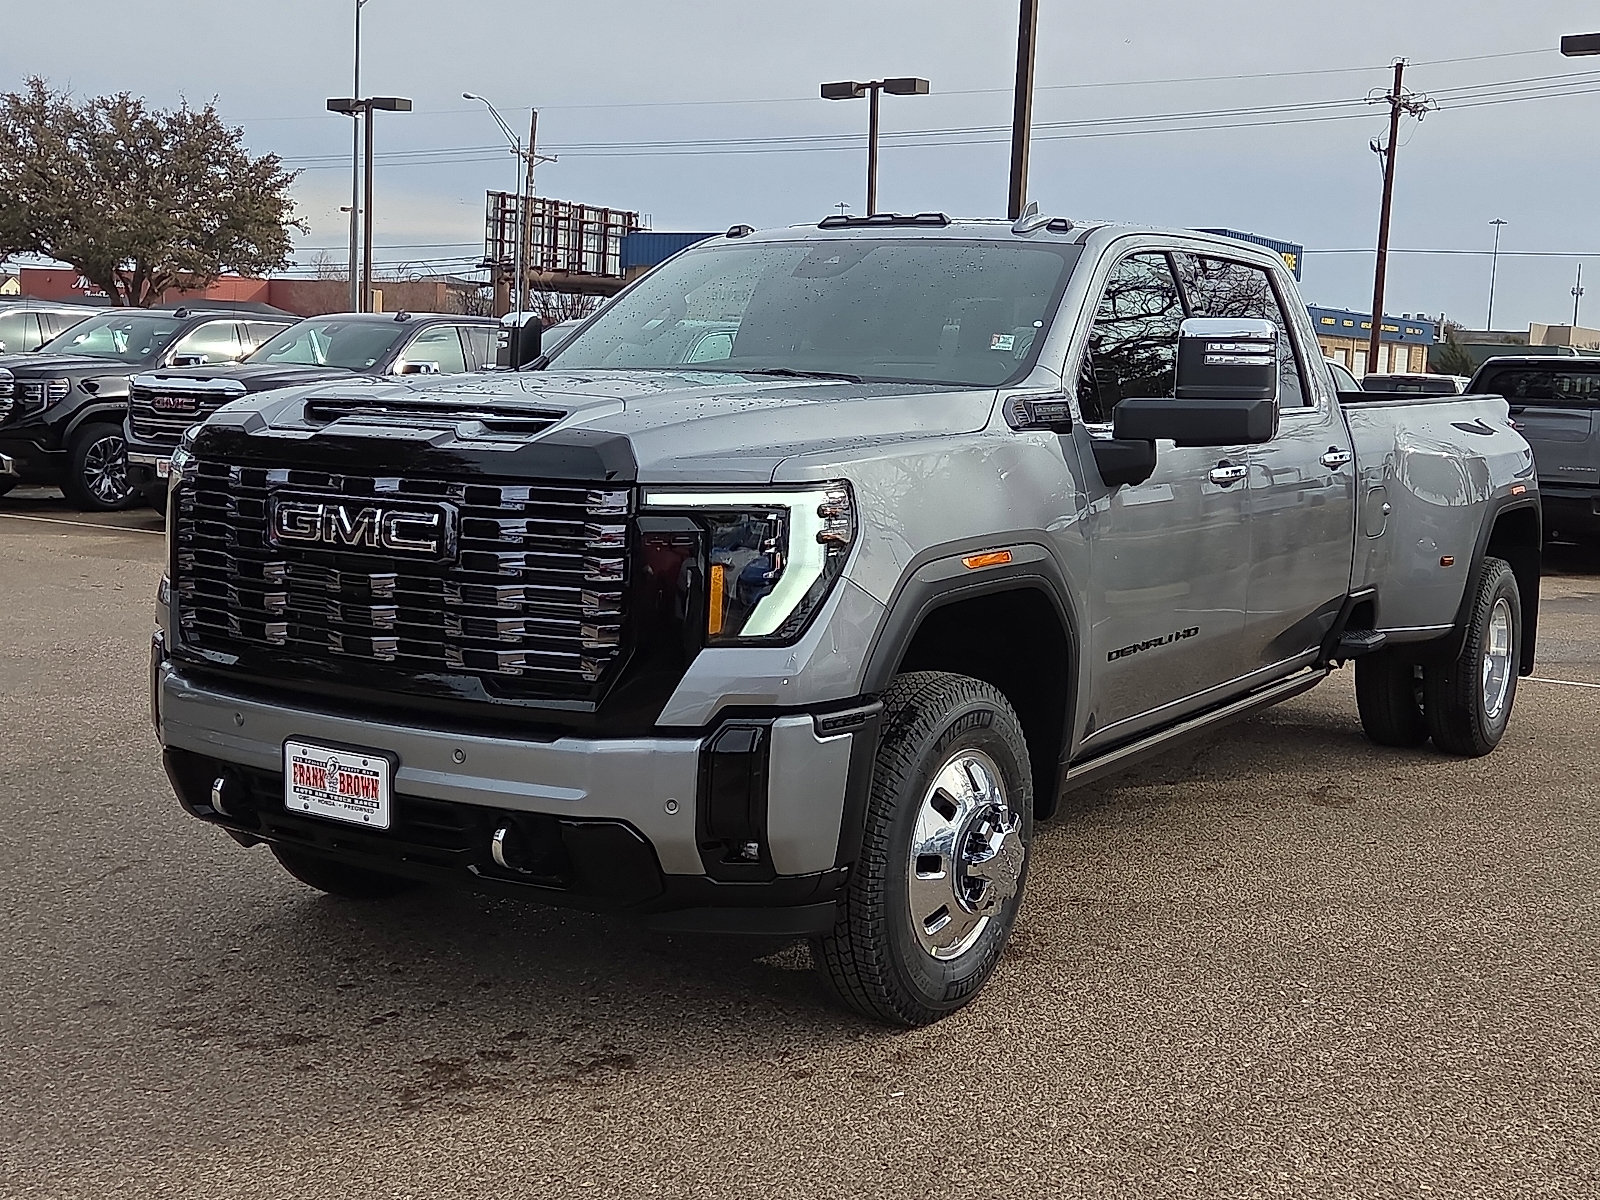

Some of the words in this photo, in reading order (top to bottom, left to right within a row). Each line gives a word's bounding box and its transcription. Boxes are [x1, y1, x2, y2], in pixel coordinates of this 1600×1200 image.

[152, 397, 195, 410] GMC
[274, 501, 439, 553] GMC
[1107, 634, 1173, 662] DENALI
[1175, 626, 1200, 642] HD
[936, 711, 993, 753] MICHELIN
[293, 763, 327, 791] FRANK
[339, 772, 379, 801] BROWN
